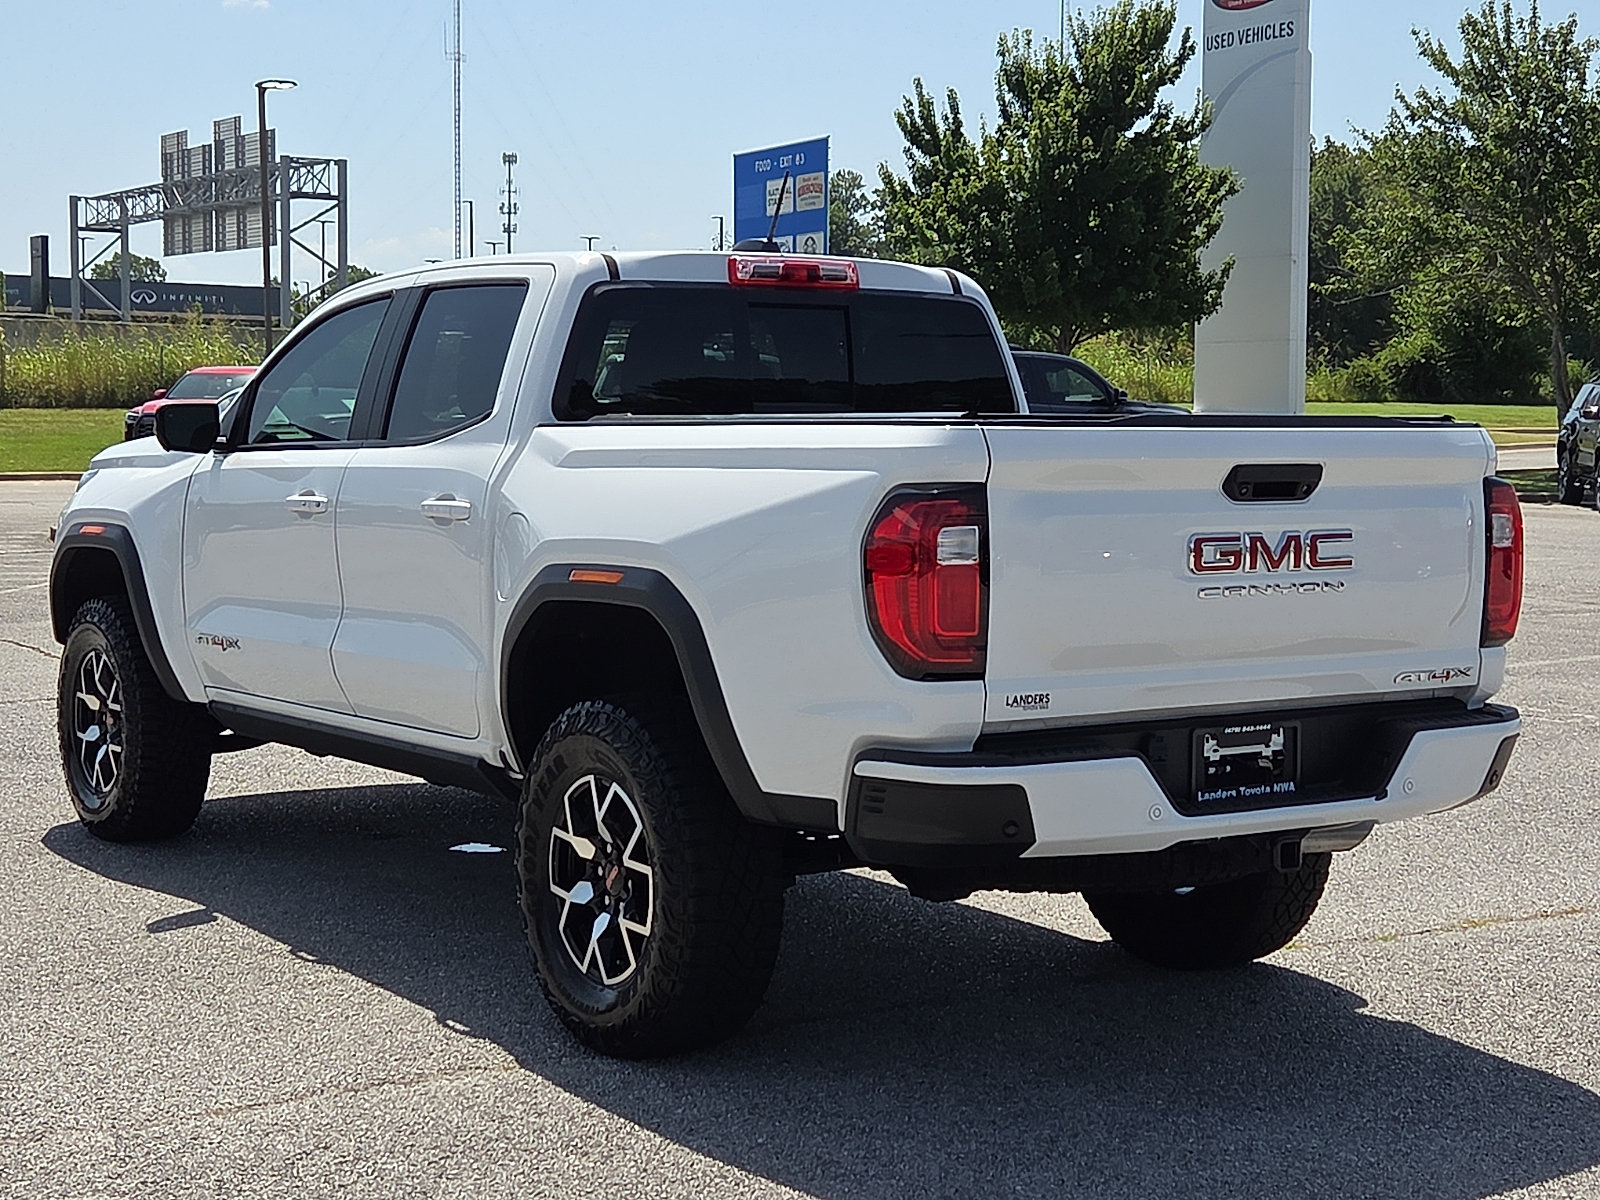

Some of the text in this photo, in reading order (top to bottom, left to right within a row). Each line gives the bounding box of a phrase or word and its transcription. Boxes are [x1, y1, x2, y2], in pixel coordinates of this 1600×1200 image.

[1206, 20, 1295, 52] USED VEHICLES
[755, 159, 771, 173] FOOD
[780, 155, 792, 168] EXIT
[162, 293, 225, 304] INFINITI
[1187, 528, 1354, 575] GMC
[1197, 580, 1347, 600] CANYON
[1005, 693, 1051, 708] LANDERS
[1197, 781, 1296, 803] Landers Toyota NWA
